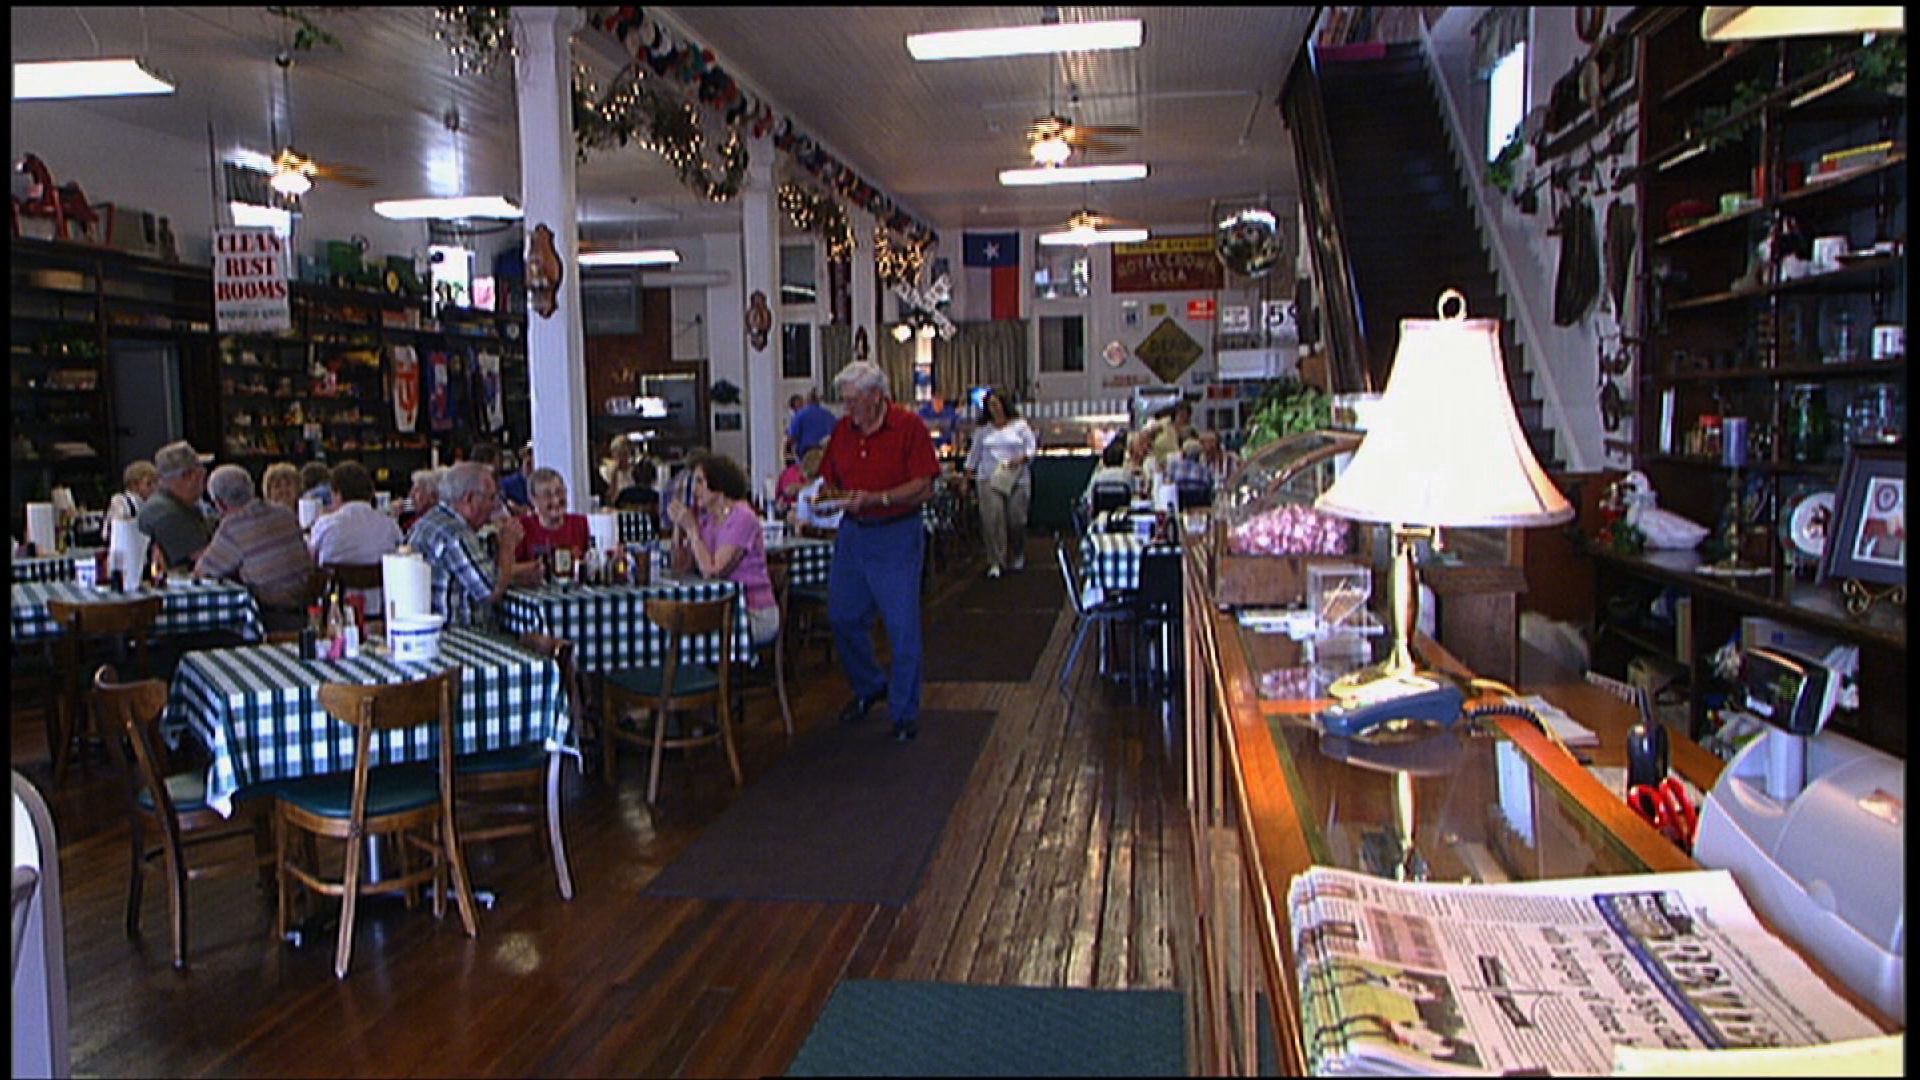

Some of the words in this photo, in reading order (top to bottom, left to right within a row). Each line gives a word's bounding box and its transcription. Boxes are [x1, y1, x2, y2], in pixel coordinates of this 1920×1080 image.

[217, 233, 282, 253] CLEAN
[225, 257, 277, 277] REST
[217, 281, 287, 301] ROOMS
